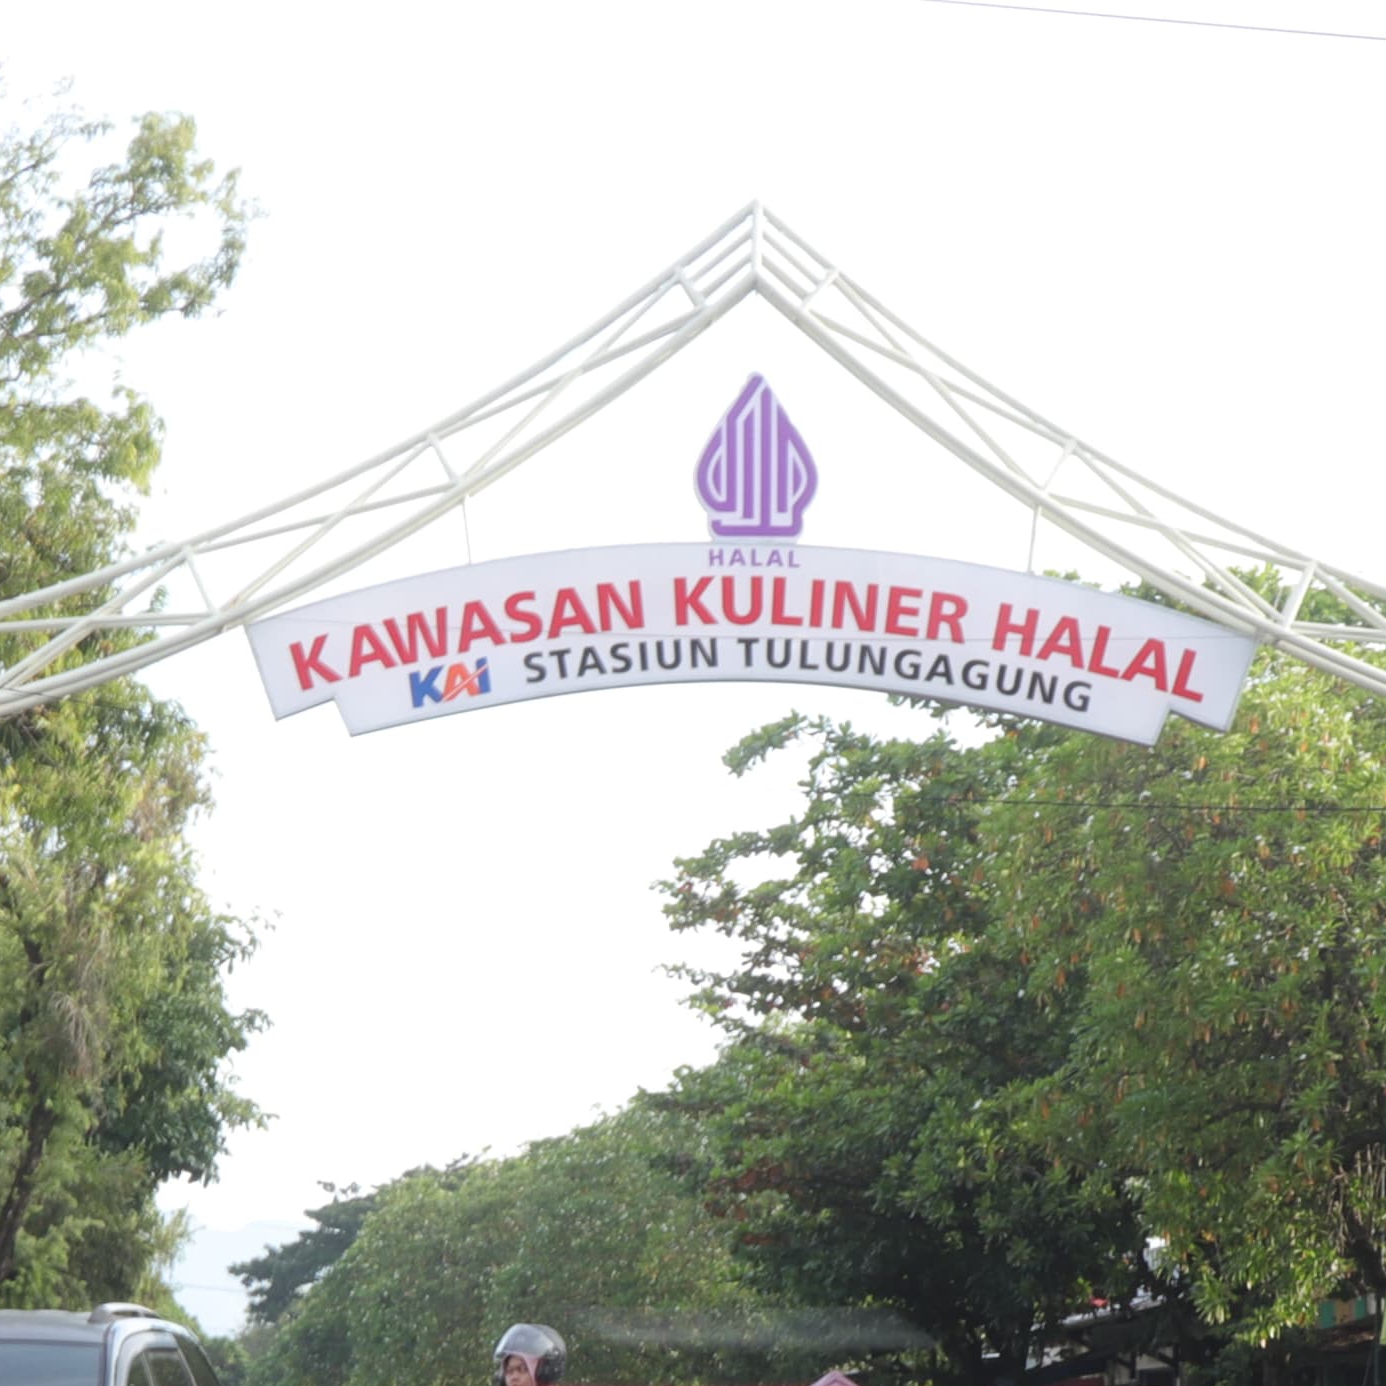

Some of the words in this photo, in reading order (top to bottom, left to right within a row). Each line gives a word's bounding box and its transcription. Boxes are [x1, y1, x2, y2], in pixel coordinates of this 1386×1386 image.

[708, 549, 801, 568] HALAL
[289, 580, 645, 691] KAWASAN
[673, 576, 968, 643] KULINER
[993, 604, 1204, 703] HALAL
[409, 656, 491, 709] KAI
[524, 638, 718, 684] STASIUN
[738, 638, 1091, 713] TULUNGAGUNG
